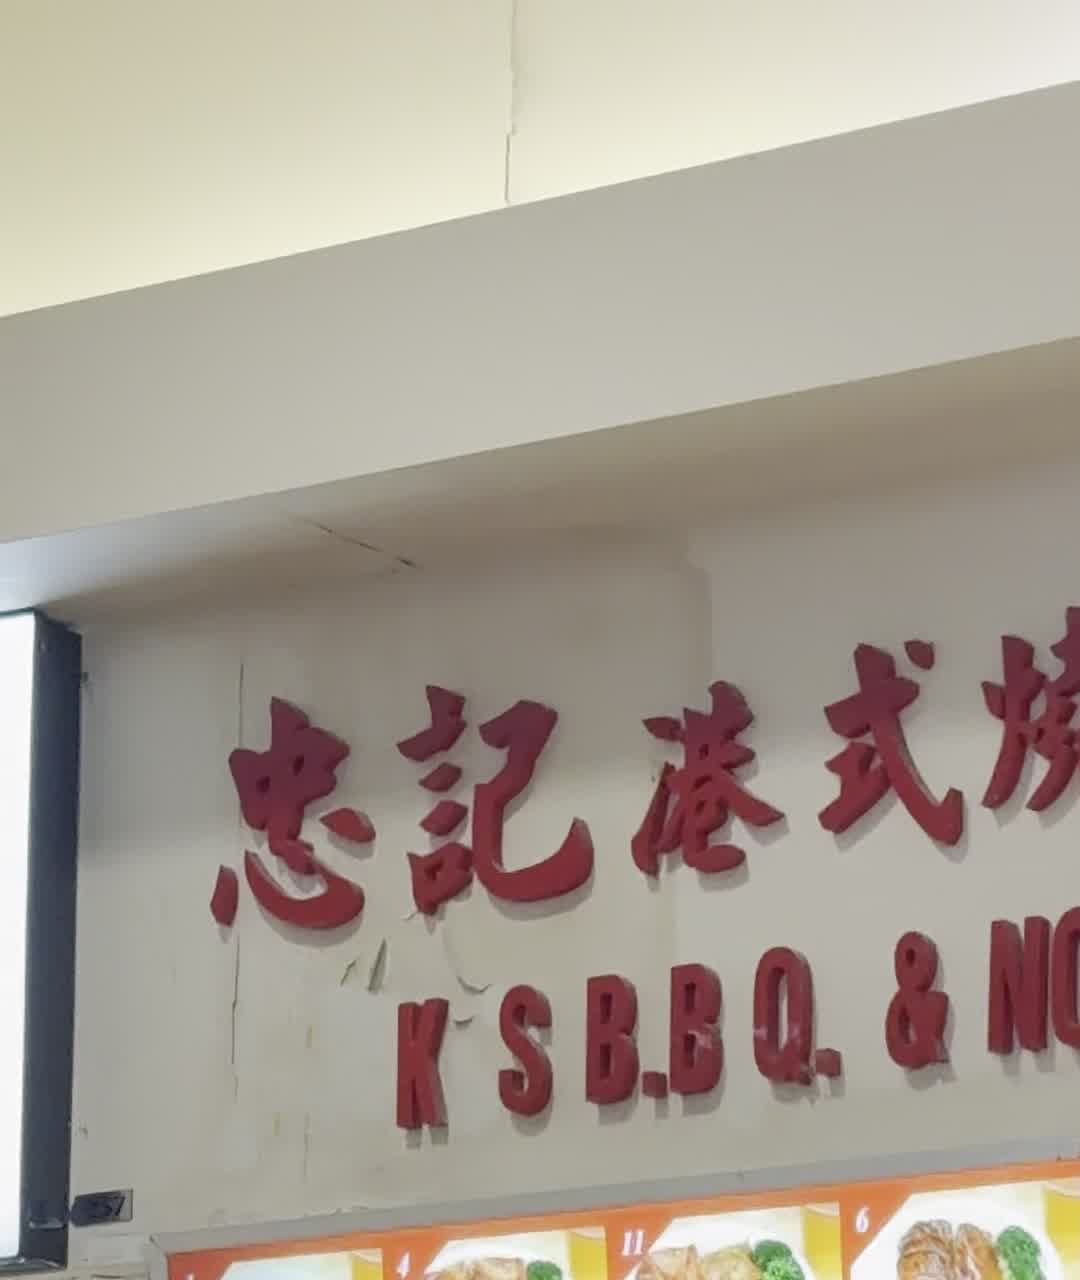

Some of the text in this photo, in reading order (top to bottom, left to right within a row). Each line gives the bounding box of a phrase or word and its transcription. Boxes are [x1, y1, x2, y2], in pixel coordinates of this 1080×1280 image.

[886, 932, 949, 1070] &
[855, 1208, 870, 1233] 6
[621, 1231, 645, 1255] 11
[397, 1253, 410, 1278] 4
